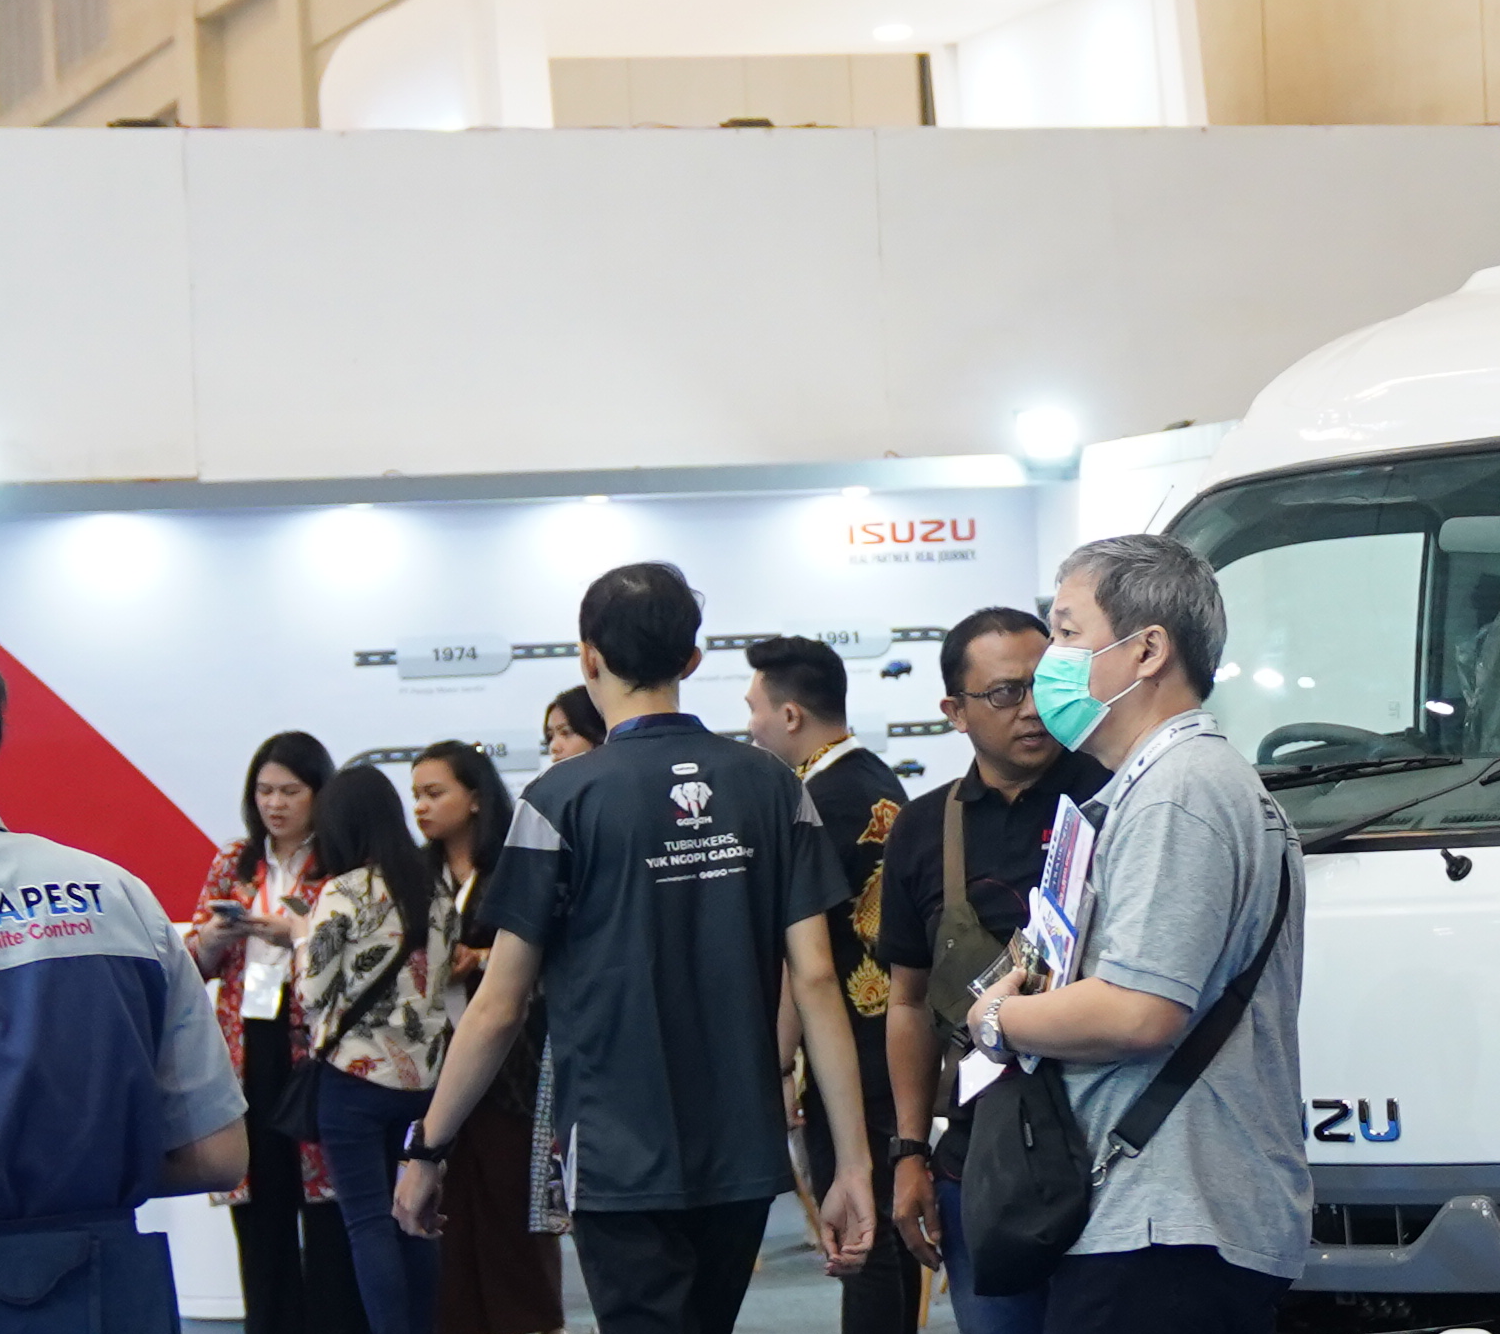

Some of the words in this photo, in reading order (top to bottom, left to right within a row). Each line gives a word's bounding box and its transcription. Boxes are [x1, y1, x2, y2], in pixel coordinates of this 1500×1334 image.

[849, 518, 976, 545] ISUZU
[915, 550, 936, 562] REAL
[816, 630, 860, 645] 1991
[432, 646, 479, 662] 1974
[645, 855, 668, 869] YUK
[670, 852, 706, 866] NGOPI
[27, 918, 95, 941] Control
